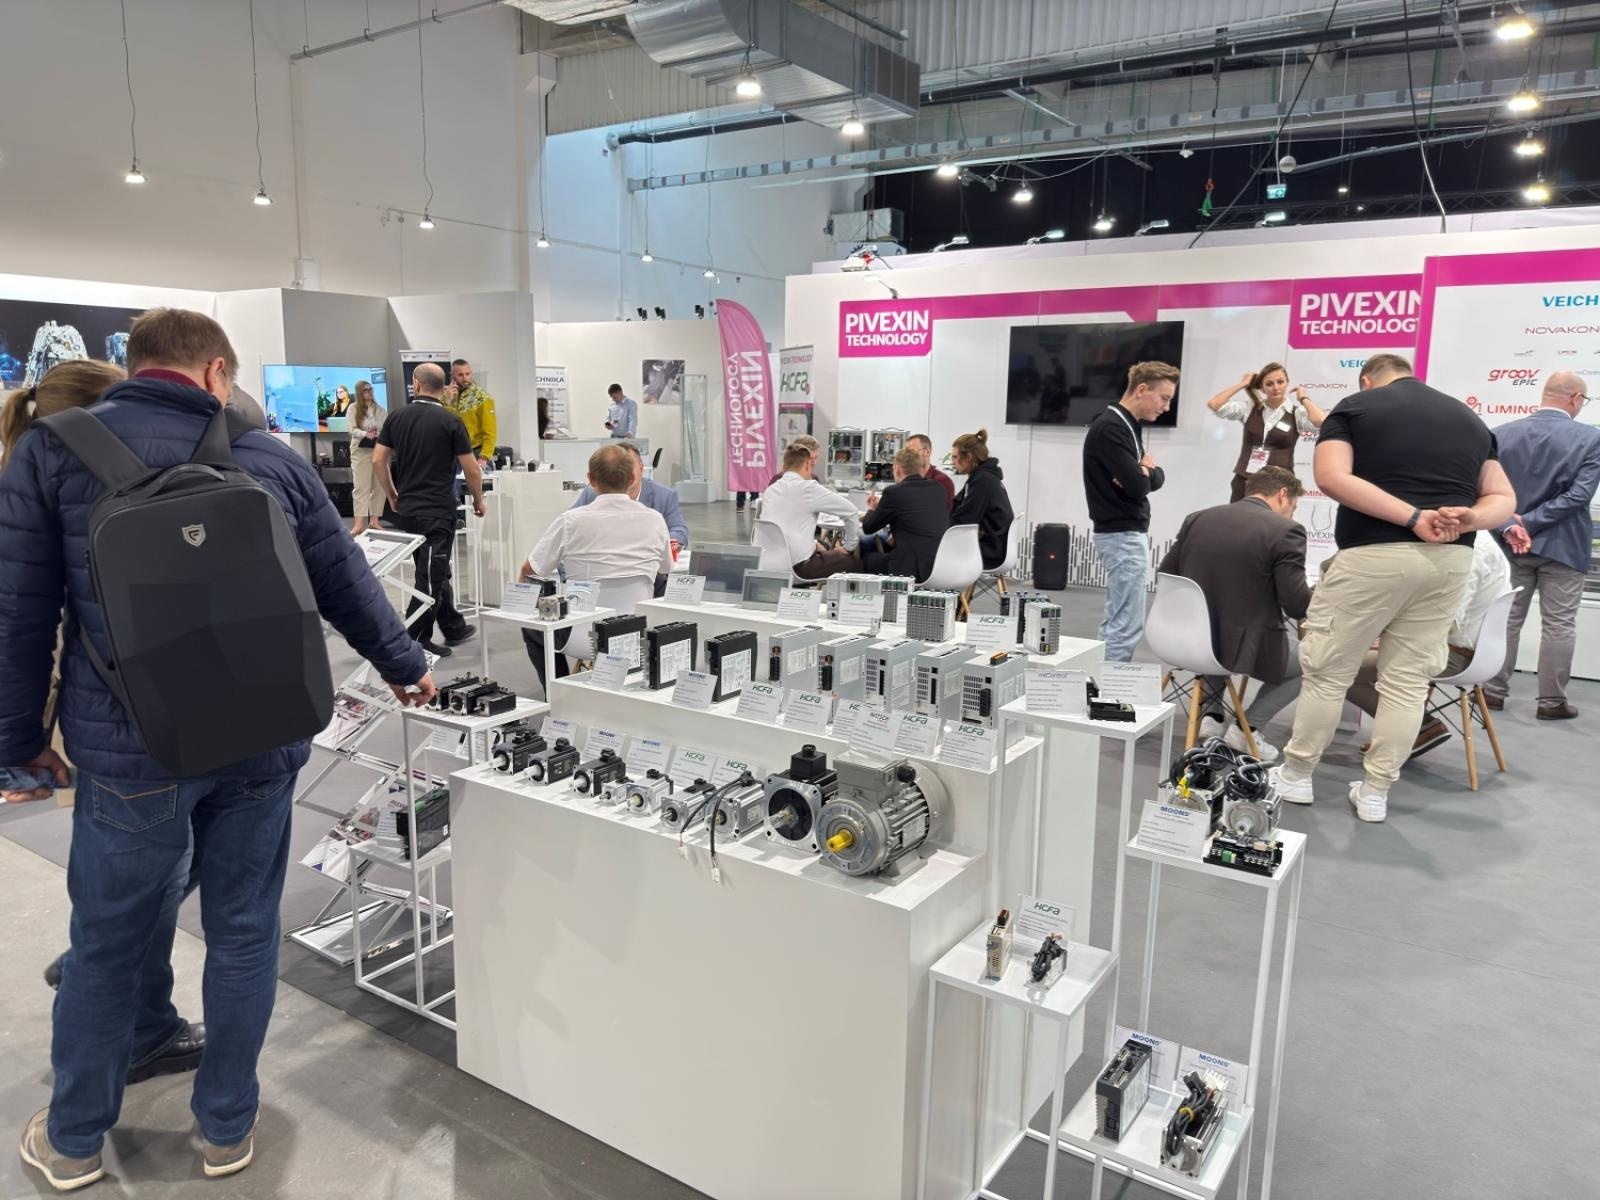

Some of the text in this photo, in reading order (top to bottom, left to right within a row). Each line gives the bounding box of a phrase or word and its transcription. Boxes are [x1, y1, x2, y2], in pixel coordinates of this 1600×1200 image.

[845, 310, 929, 333] PIVEXIN
[1300, 317, 1420, 335] TECHNOLOG
[1524, 325, 1599, 335] NOVAKON
[845, 332, 928, 347] TECHNOLOGY
[1488, 368, 1541, 381] groov
[1487, 405, 1540, 415] LIMING
